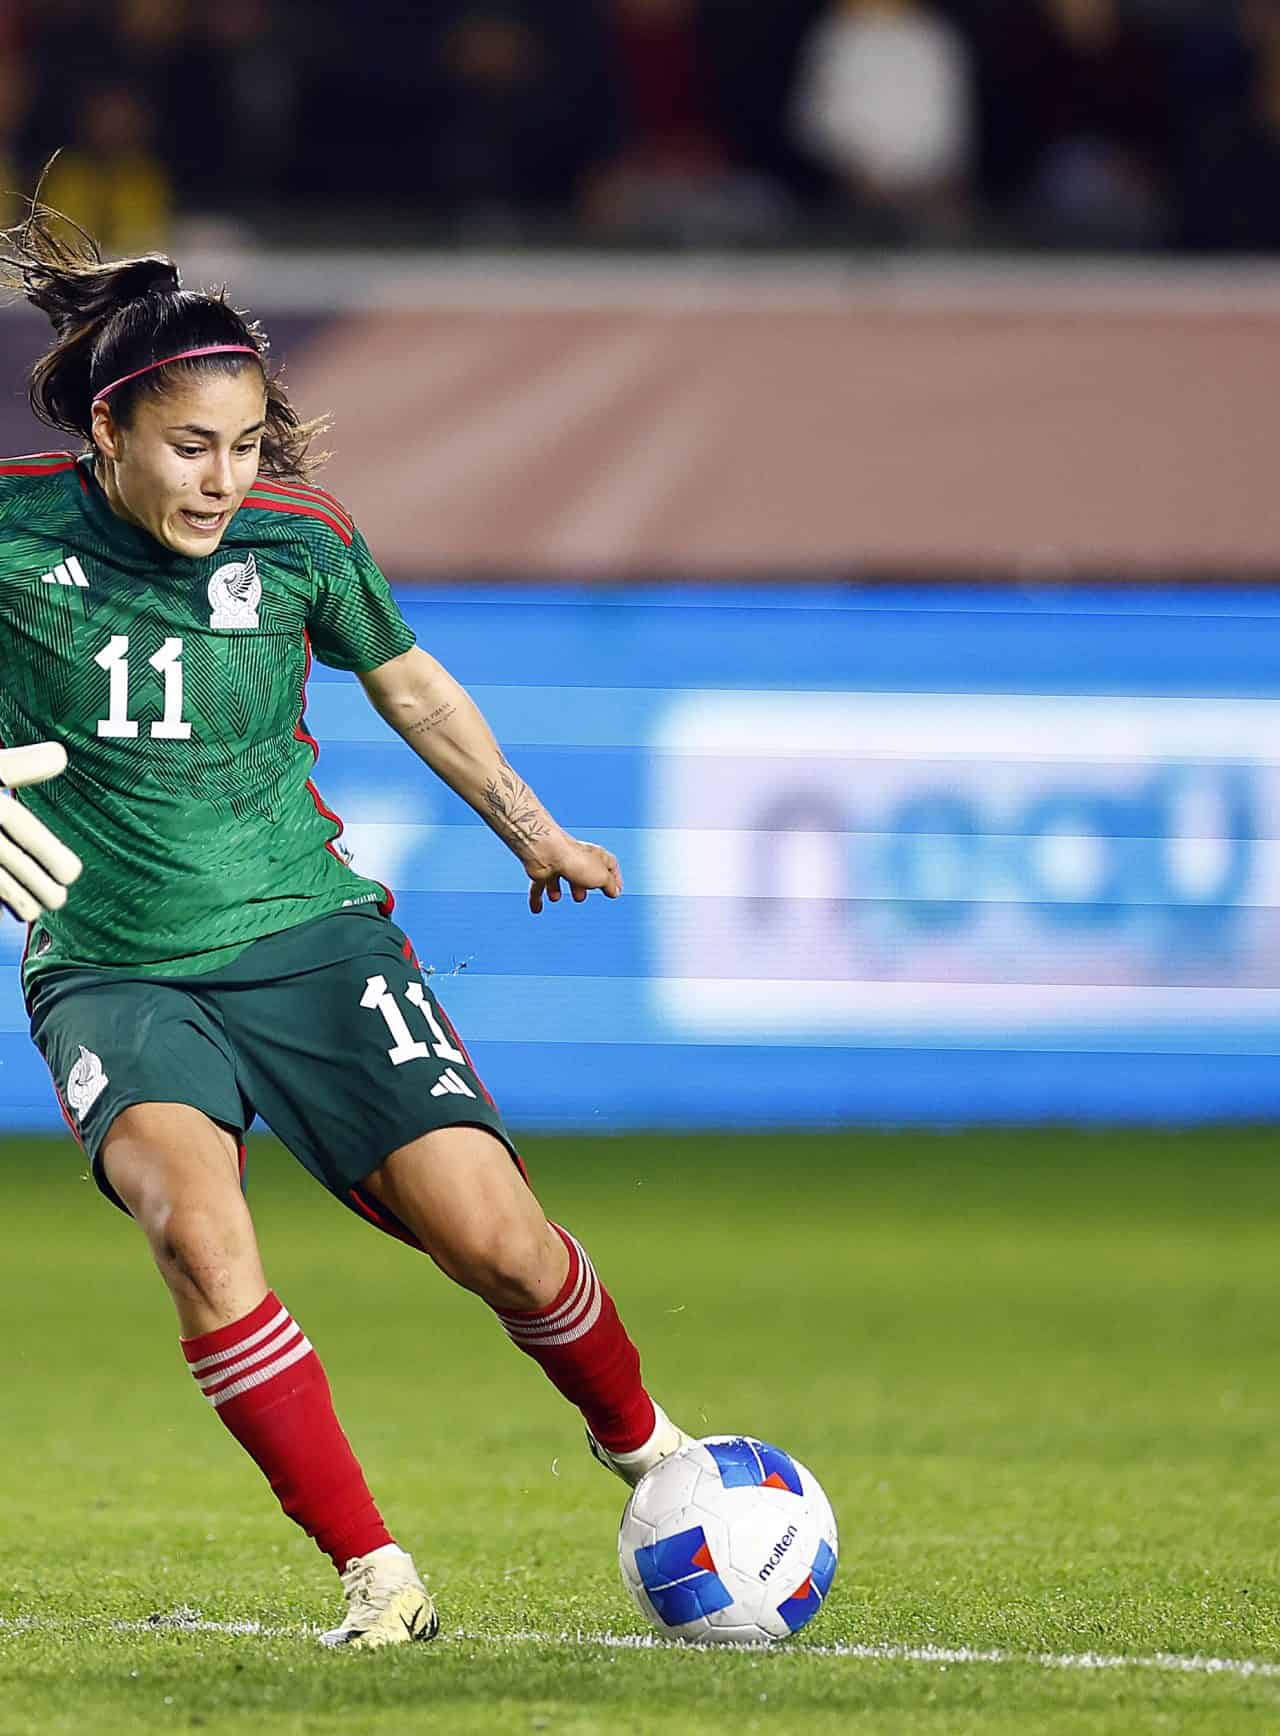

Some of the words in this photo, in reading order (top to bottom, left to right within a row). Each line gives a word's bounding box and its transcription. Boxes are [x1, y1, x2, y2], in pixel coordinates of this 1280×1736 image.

[93, 635, 192, 739] 11
[359, 974, 467, 1066] 11
[757, 1524, 798, 1582] molten
